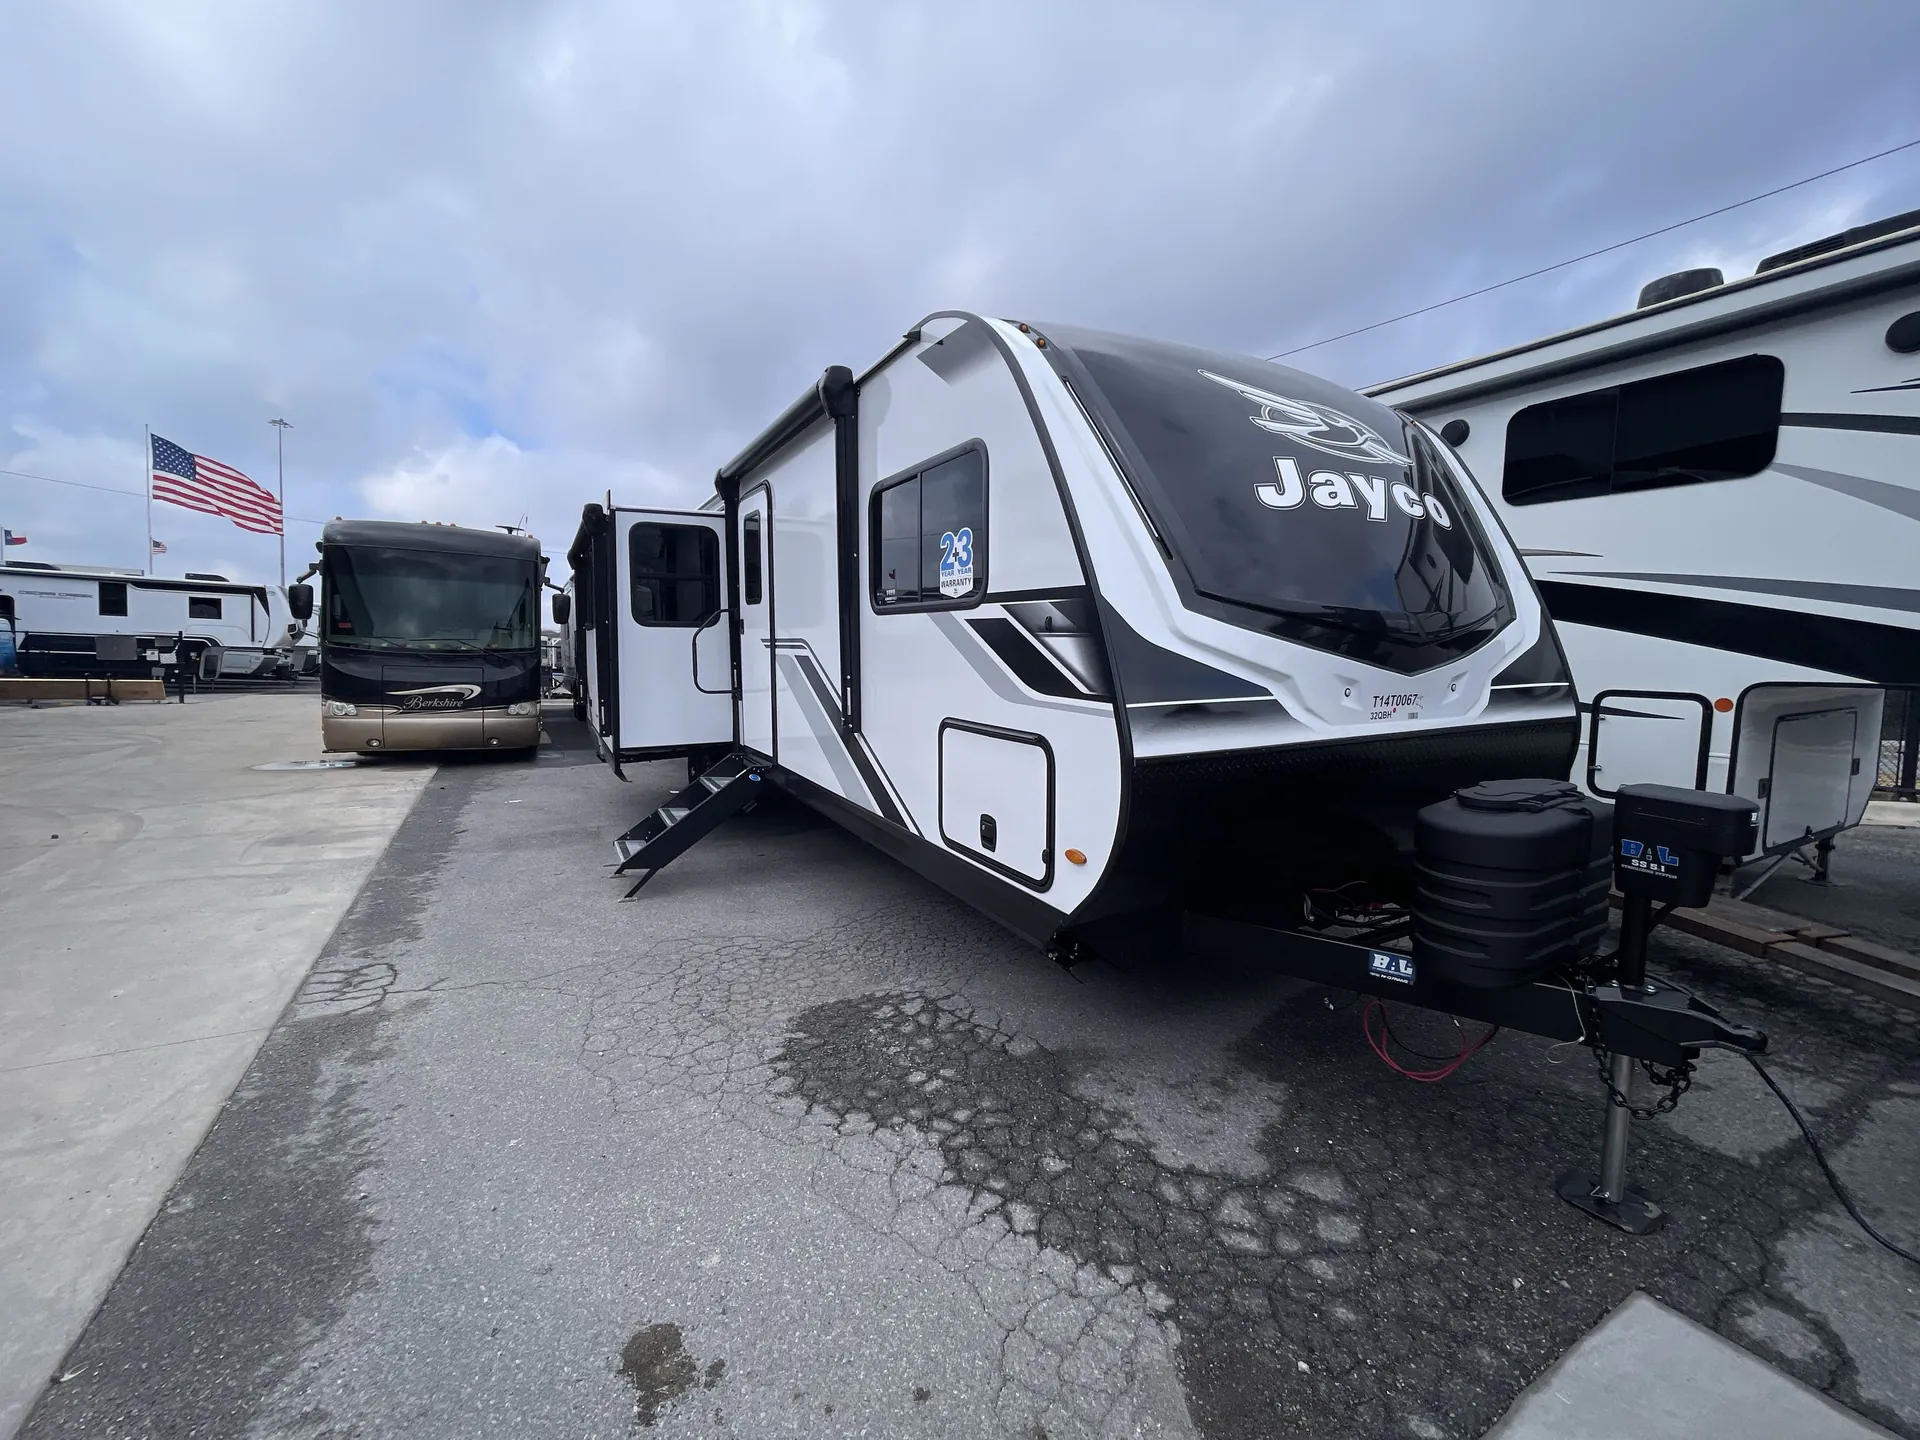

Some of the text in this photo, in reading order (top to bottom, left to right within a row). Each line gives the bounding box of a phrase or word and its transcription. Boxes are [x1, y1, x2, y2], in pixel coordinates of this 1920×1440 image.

[1254, 456, 1452, 531] Jayco
[941, 577, 972, 588] WARRANTY
[403, 695, 463, 709] Berkshire
[1373, 694, 1418, 708] T14T0067
[1370, 711, 1392, 720] 32QBH
[1372, 953, 1413, 975] BAL
